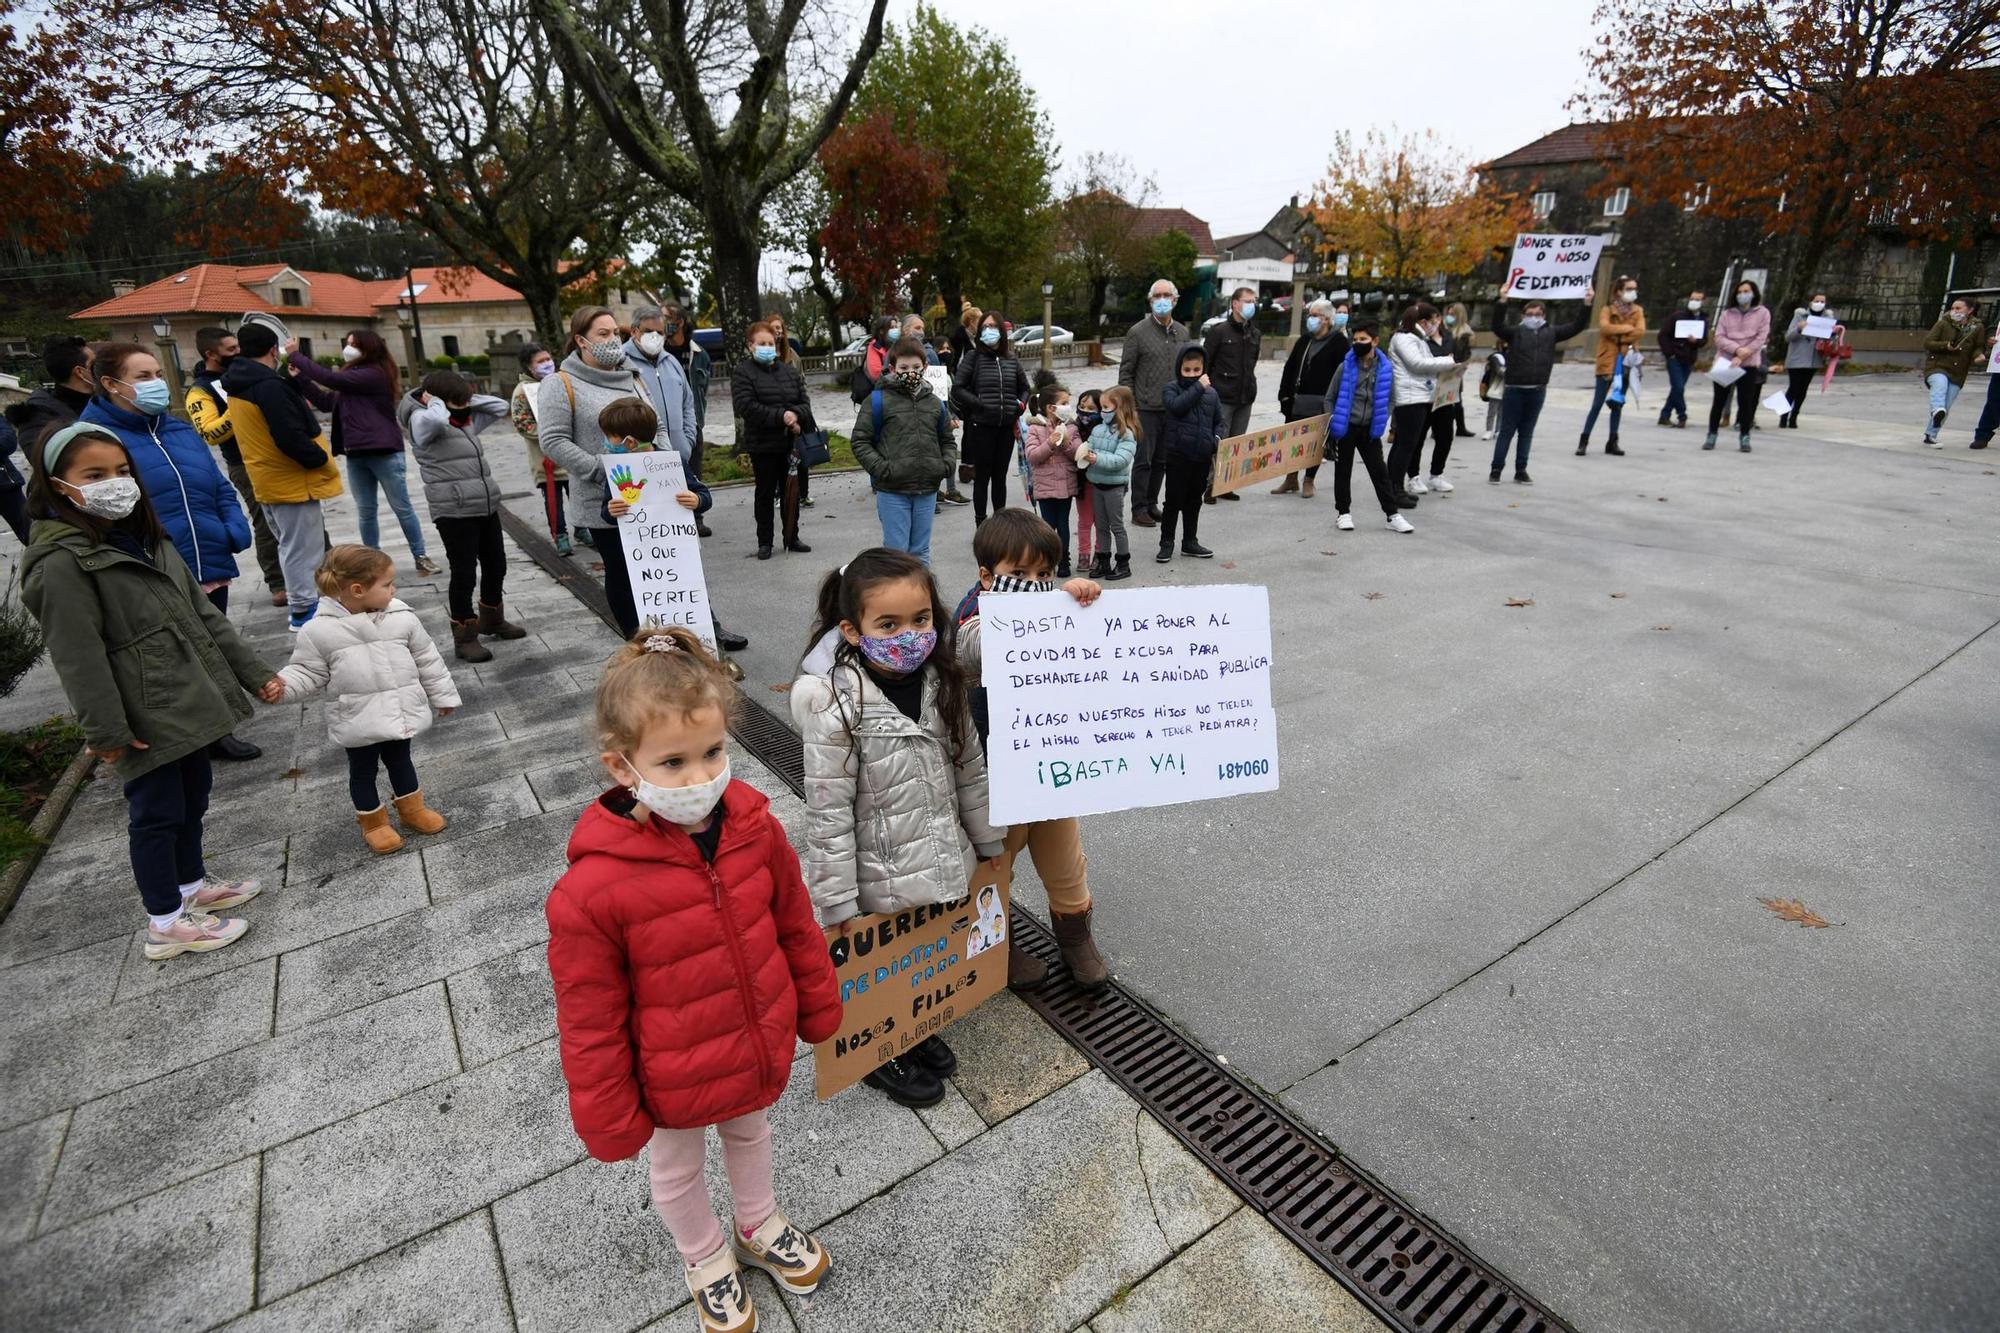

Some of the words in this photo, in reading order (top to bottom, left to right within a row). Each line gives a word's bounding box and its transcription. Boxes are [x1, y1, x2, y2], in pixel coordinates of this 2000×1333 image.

[1536, 251, 1546, 262] O
[1555, 251, 1591, 263] NOSO
[638, 524, 697, 542] PEDIMOS
[632, 548, 643, 561] O
[651, 546, 677, 559] QUE
[642, 568, 678, 582] NOS
[642, 590, 700, 607] PERTE
[646, 610, 697, 628] NECE
[1104, 617, 1122, 637] YA
[1133, 618, 1149, 632] DE
[1157, 614, 1196, 628] PONER
[1209, 613, 1231, 627] AL
[1006, 646, 1076, 663] COVID19
[1082, 647, 1101, 659] DE
[1114, 645, 1173, 658] EXCUSA
[1189, 643, 1219, 655] PARA
[1009, 670, 1109, 688] DESMANTELAR
[1122, 670, 1140, 683] LA
[1150, 665, 1209, 682] SANIDAD
[1219, 656, 1268, 678] PUBLICA
[1011, 708, 1068, 730] ¿ACASO
[1079, 708, 1145, 722] NUESTROS
[1195, 704, 1211, 715] NO
[1217, 699, 1253, 711] TIENEN
[1013, 738, 1031, 751] EL
[1095, 731, 1136, 744] DERECHO
[1145, 729, 1153, 739] A
[1161, 724, 1193, 738] TENER
[1199, 717, 1258, 733] PEDIATRA?
[1150, 753, 1186, 775] YA!
[1218, 758, 1269, 781] 090481
[841, 936, 948, 1004] PEDIATRA
[911, 953, 959, 988] PARA
